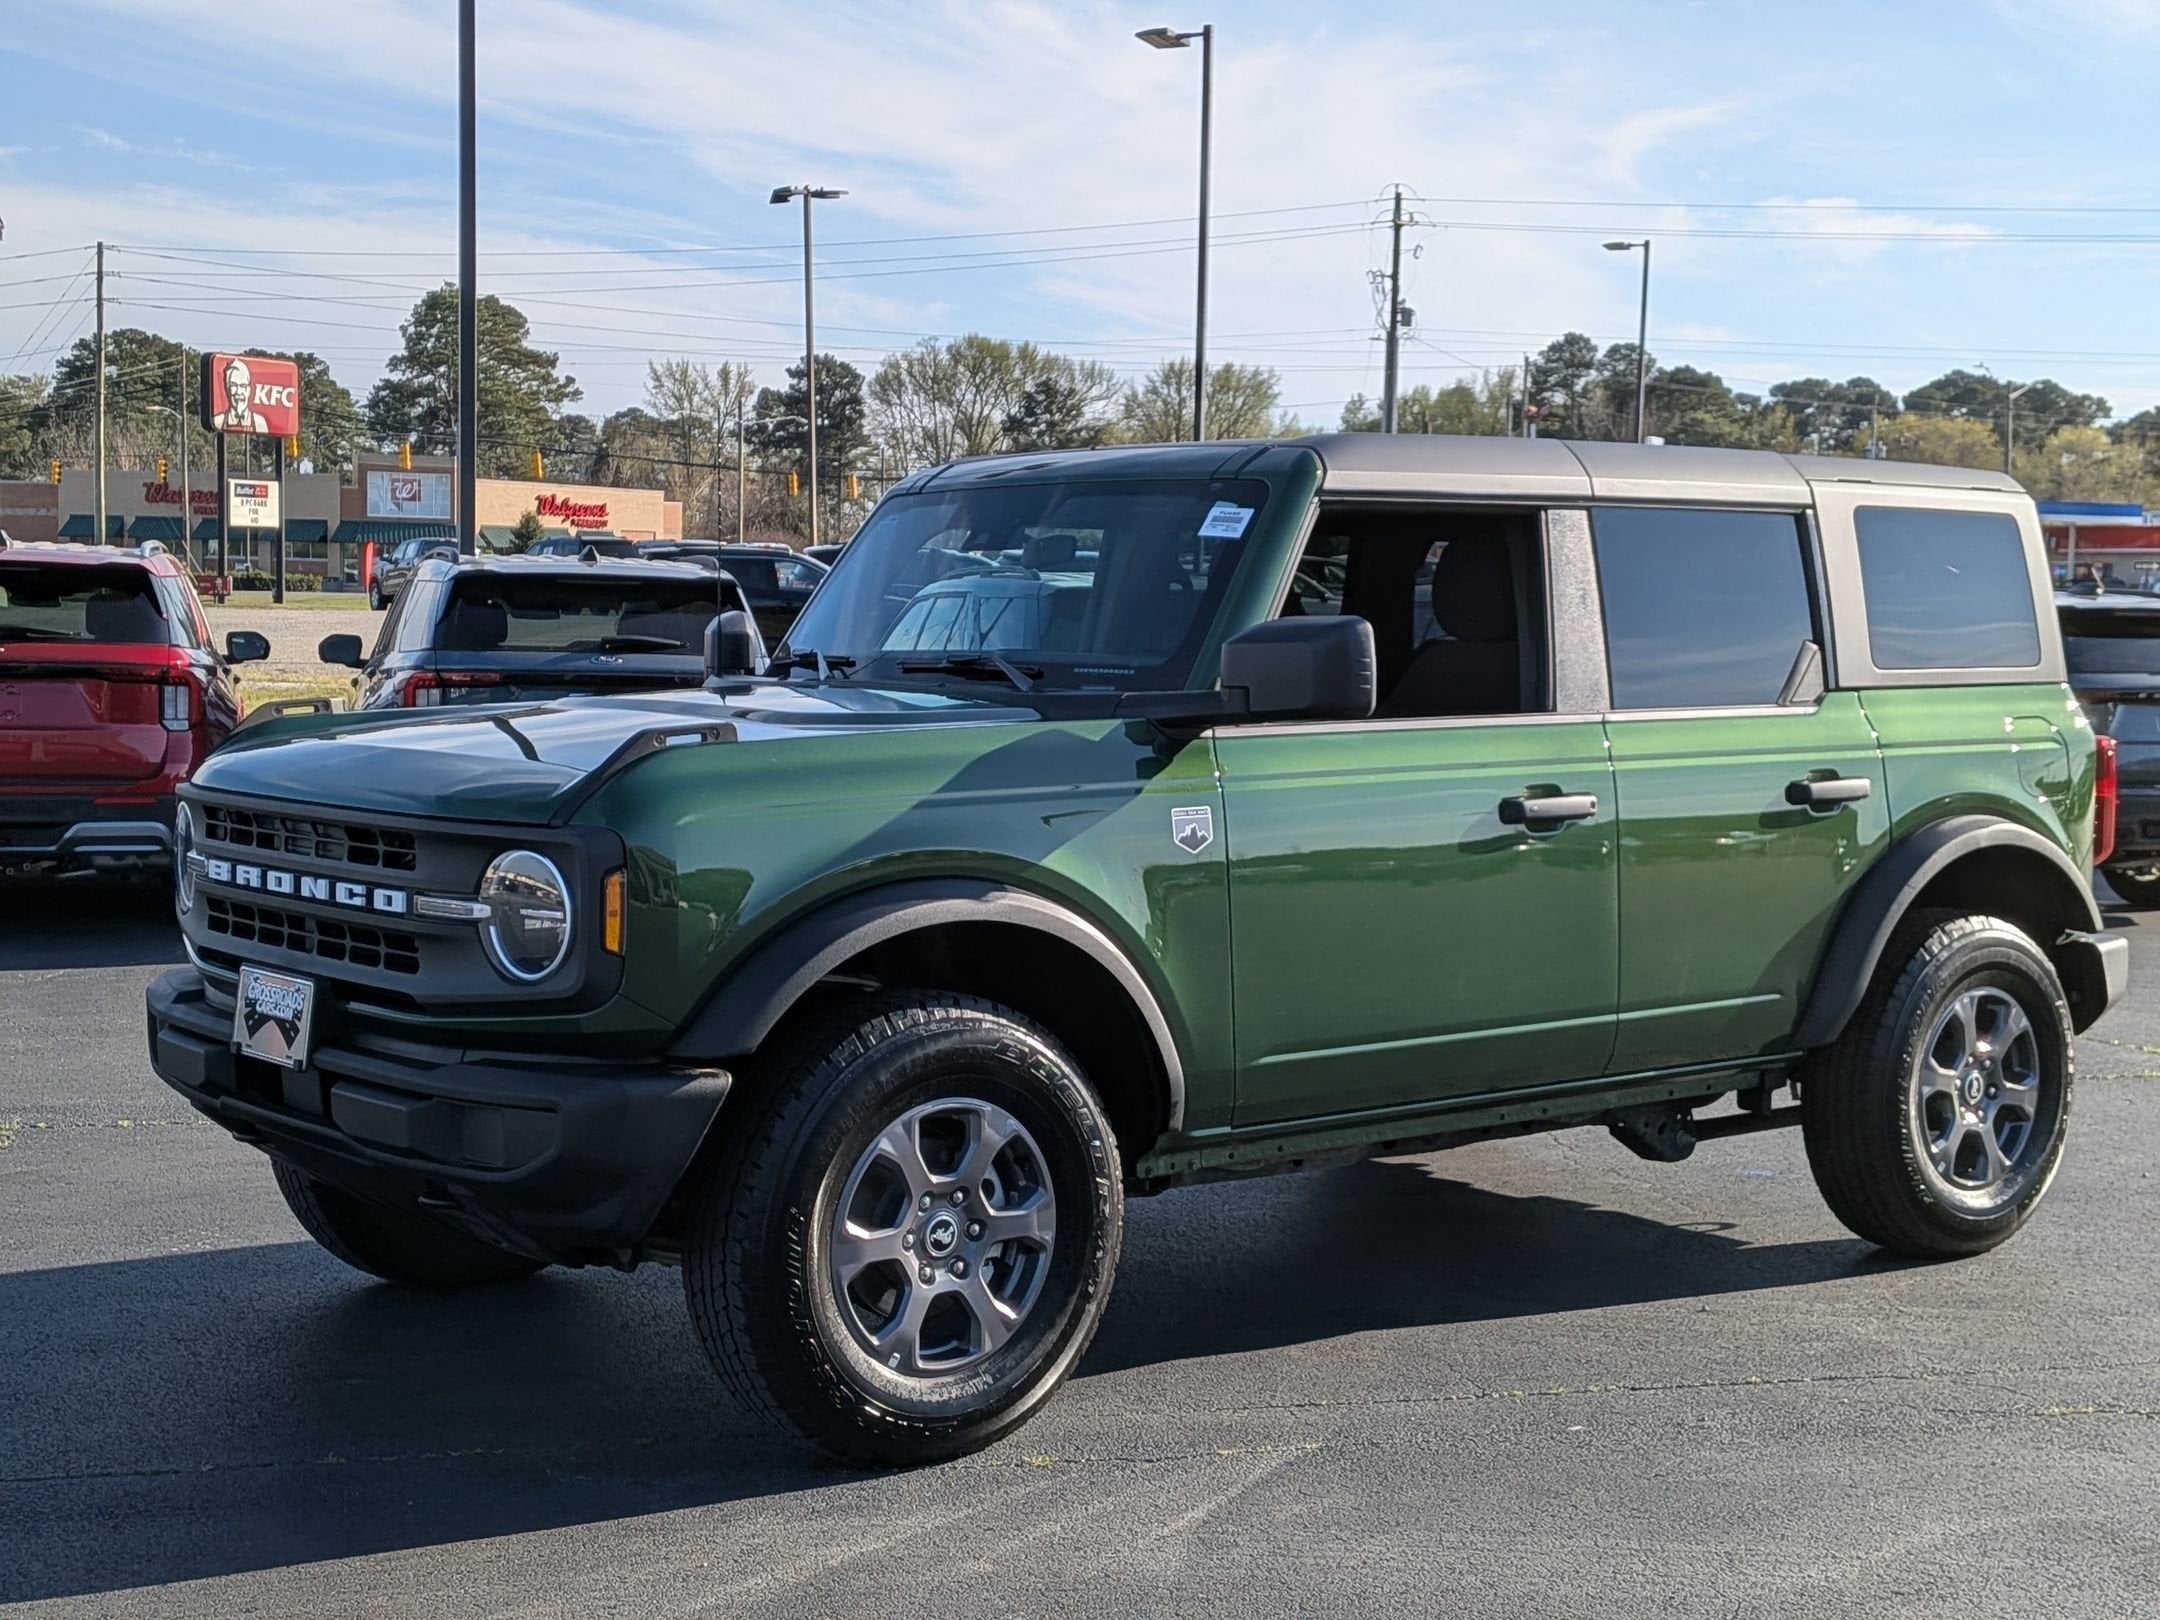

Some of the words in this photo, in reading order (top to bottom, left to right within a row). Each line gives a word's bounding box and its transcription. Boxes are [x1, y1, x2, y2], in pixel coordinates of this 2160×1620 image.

[253, 383, 296, 408] KFC
[534, 493, 610, 524] Walgreens
[208, 859, 407, 913] BRONCO
[247, 981, 305, 1011] CROSSROADS
